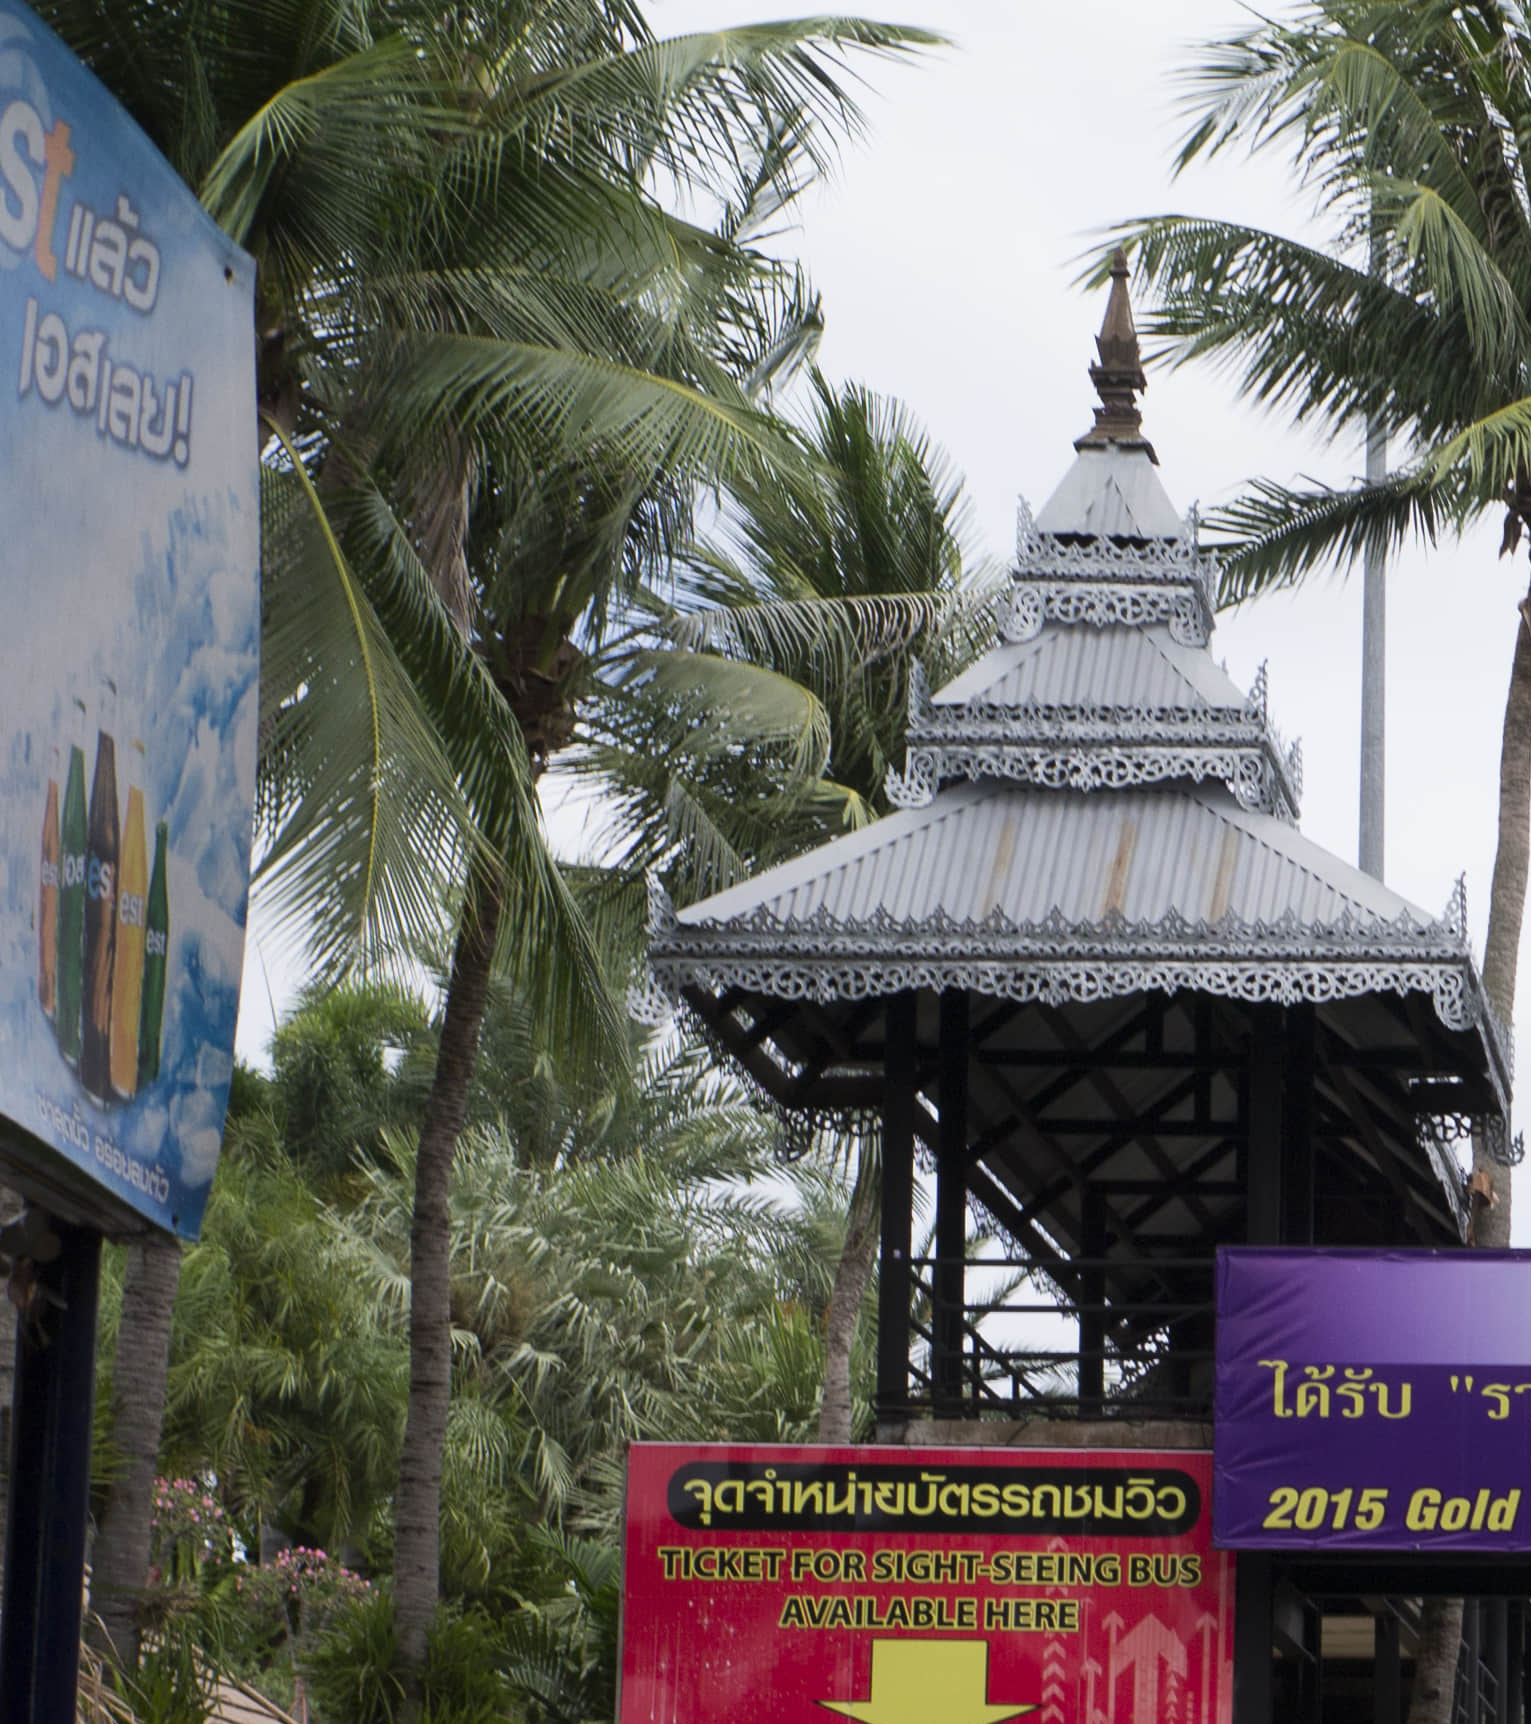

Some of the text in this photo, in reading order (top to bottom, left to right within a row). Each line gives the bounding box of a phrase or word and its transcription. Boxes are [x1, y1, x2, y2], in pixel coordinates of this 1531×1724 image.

[0, 100, 75, 281] st
[66, 192, 160, 313] แล้ว
[1259, 1361, 1412, 1420] ได้รับ
[684, 1469, 1187, 1525] จุดจำหน่ายบัตรรถชมวิว
[1263, 1487, 1388, 1531] 2015
[1406, 1488, 1519, 1534] Gold
[659, 1547, 1202, 1588] TICKET FOR SIGHT-SEEING BUS
[779, 1597, 1080, 1633] AVAILABLE HERE
